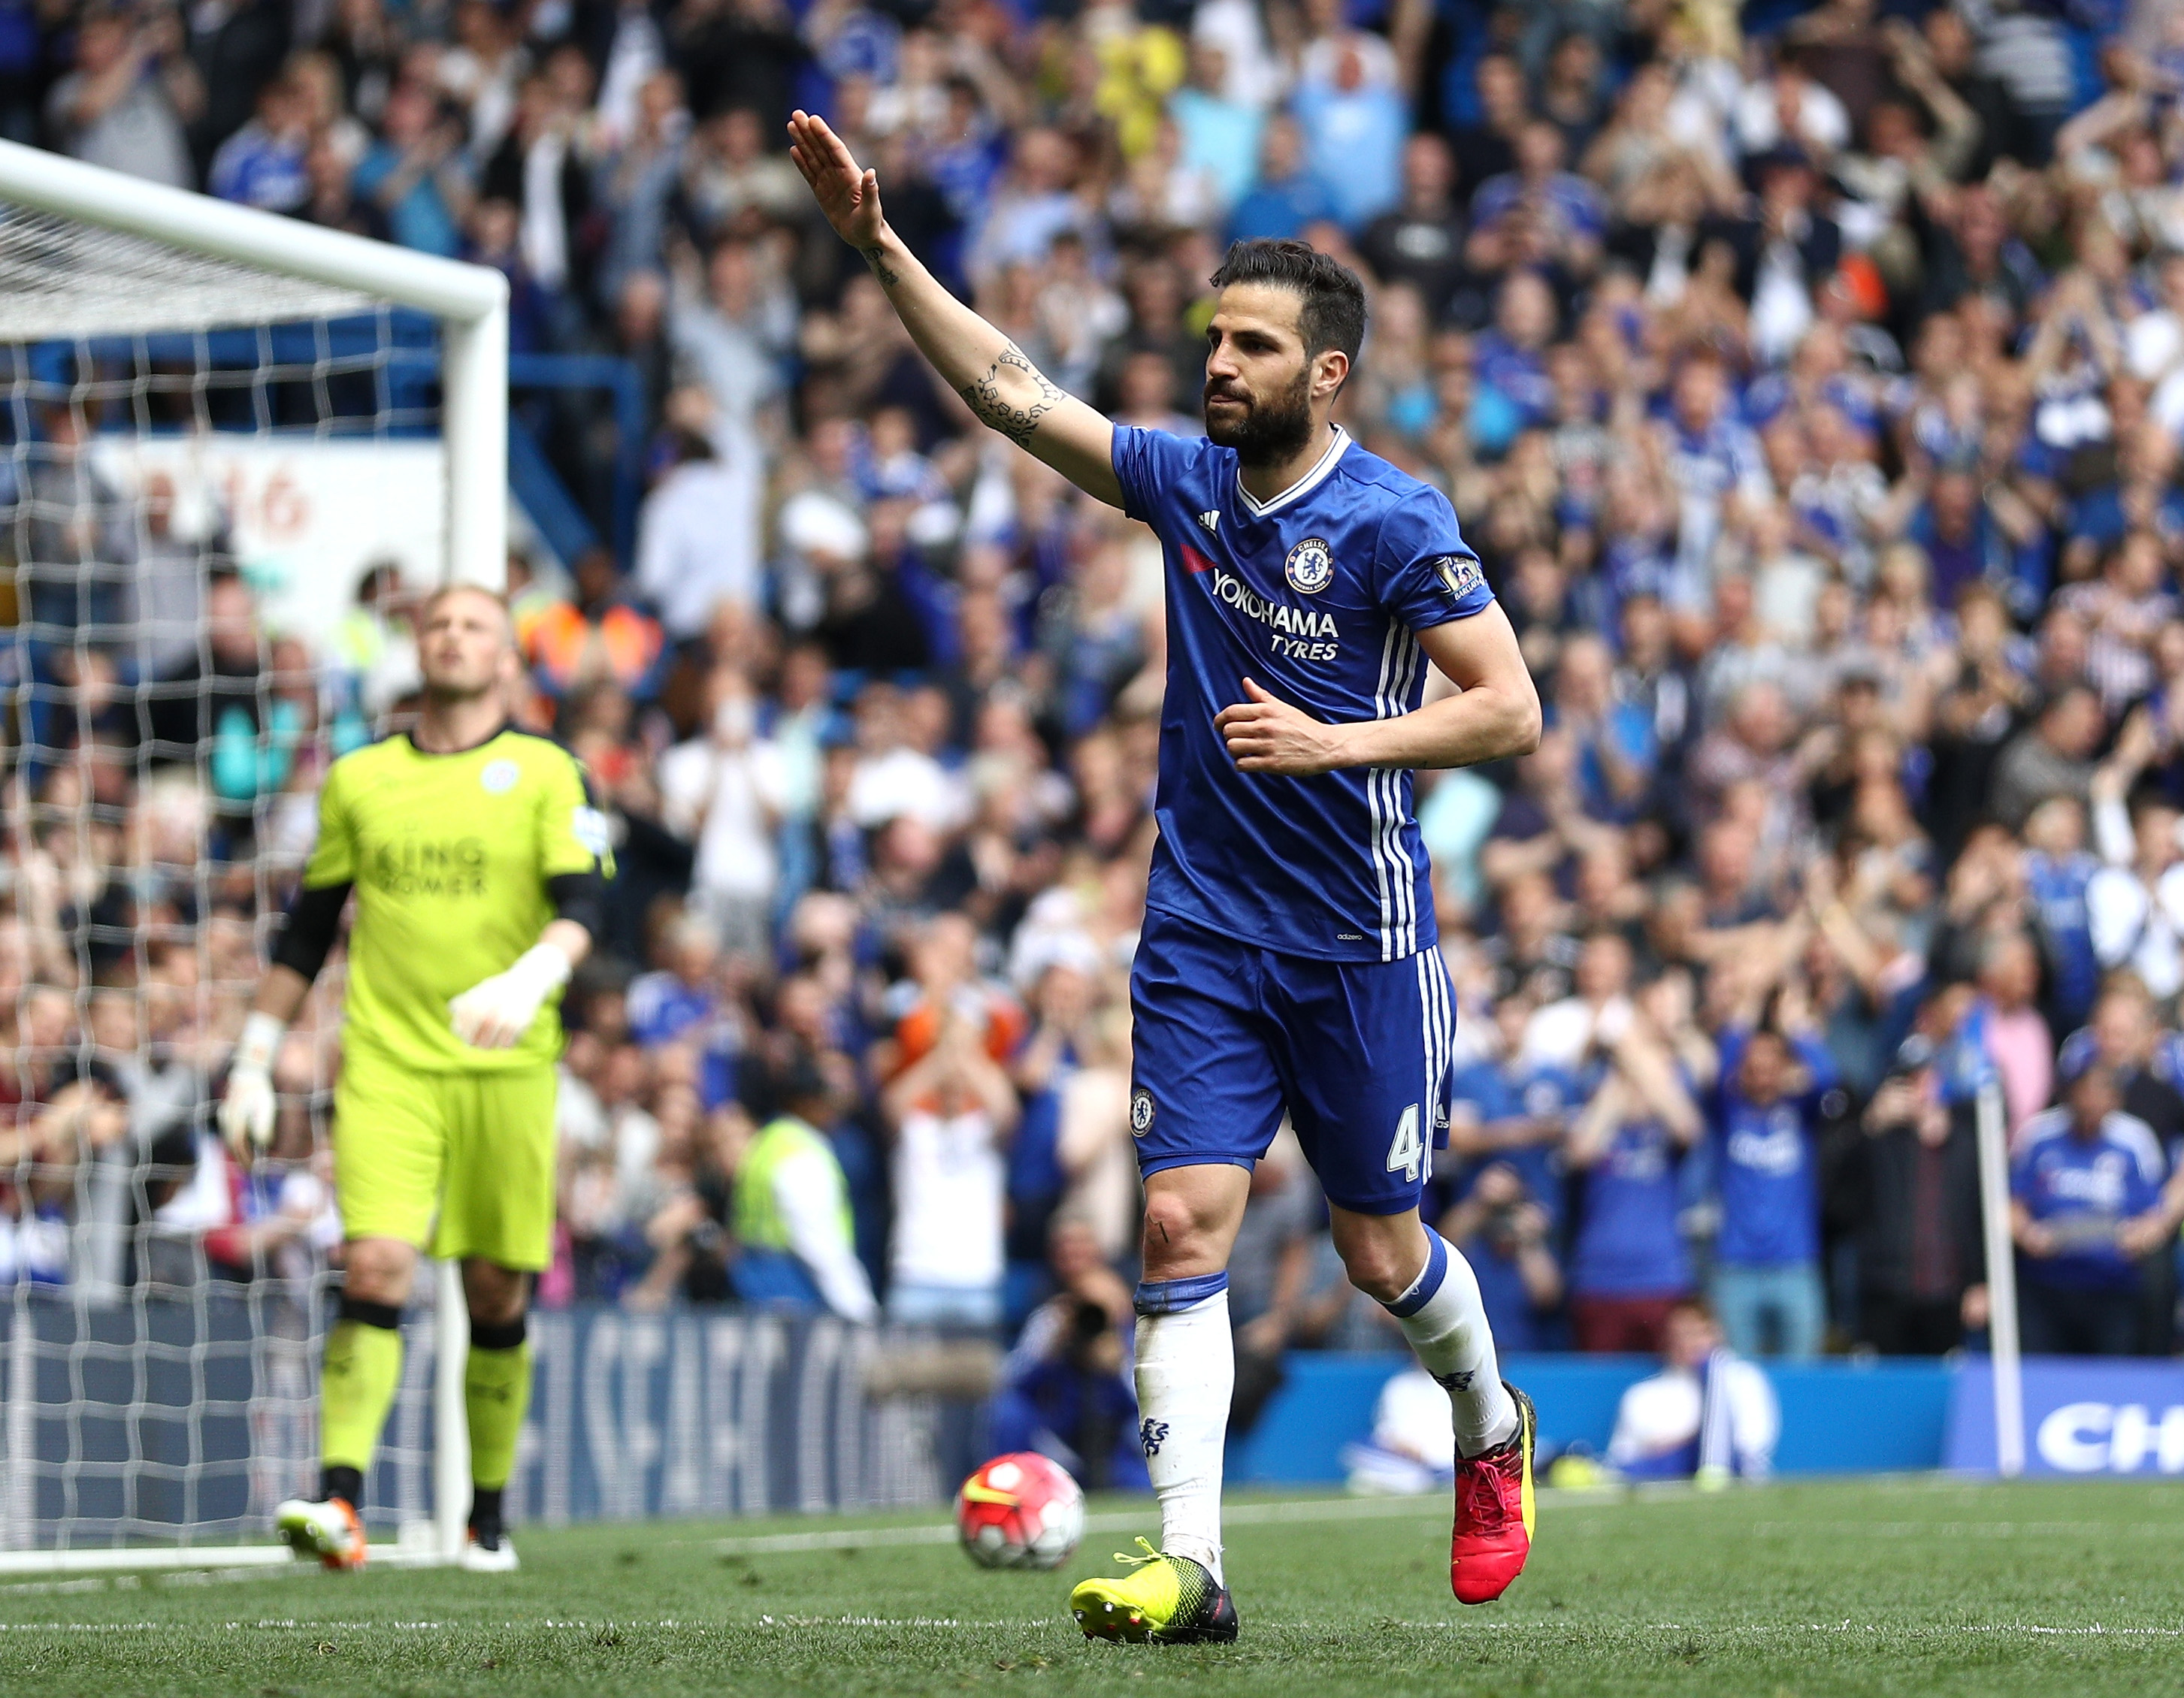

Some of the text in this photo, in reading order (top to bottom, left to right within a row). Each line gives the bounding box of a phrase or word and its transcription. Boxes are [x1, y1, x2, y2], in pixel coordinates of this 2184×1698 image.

[1298, 541, 1329, 553] CHELSEA
[1212, 567, 1339, 638] YOKOHAMA
[1271, 634, 1339, 660] TYRES
[376, 835, 487, 870] KING
[1387, 1102, 1423, 1183] 4
